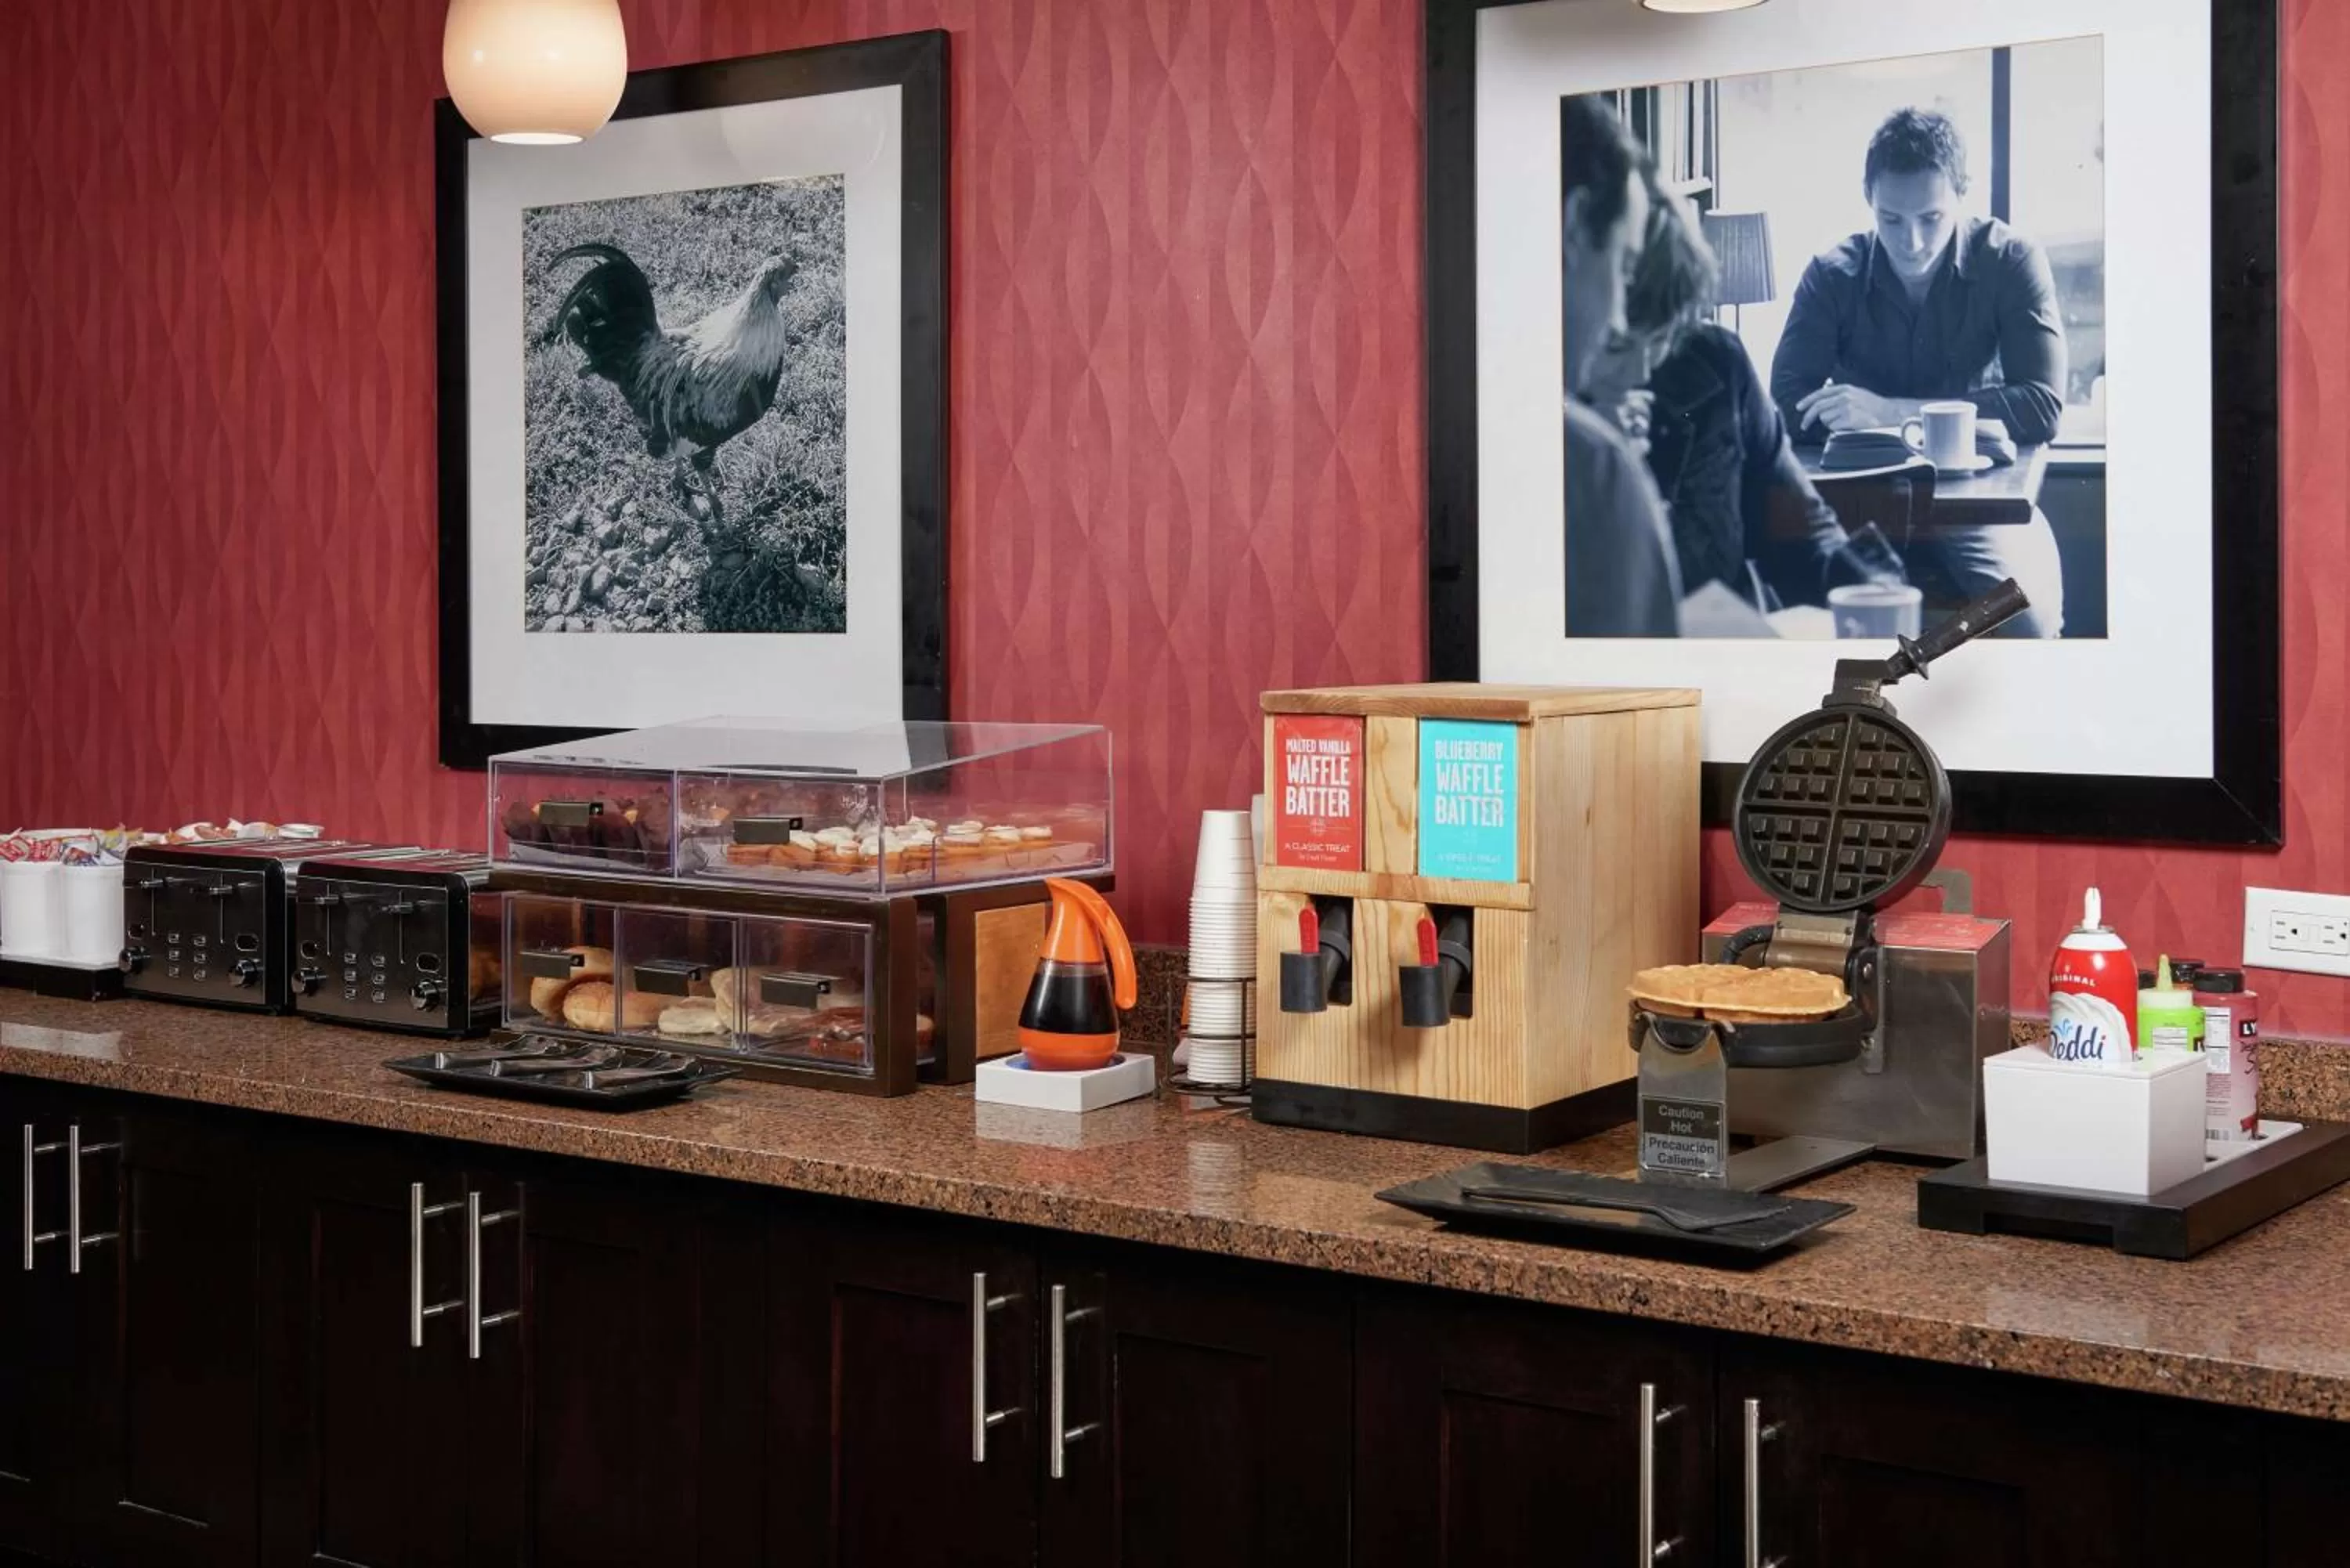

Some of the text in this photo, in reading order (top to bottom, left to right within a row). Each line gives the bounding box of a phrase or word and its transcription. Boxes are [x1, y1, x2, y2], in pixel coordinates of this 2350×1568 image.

[1285, 739, 1351, 754] MALTED VANILLA
[1434, 739, 1504, 761] BLUEBERRY
[1285, 754, 1350, 786] WAFFLE
[1434, 762, 1505, 794] WAFFLE
[1285, 786, 1350, 818] BATTER
[1434, 795, 1505, 828] BATTER
[1292, 842, 1325, 852] CLASSIC
[1325, 844, 1352, 853] TREAT
[1658, 1104, 1705, 1120] Caution
[1670, 1121, 1693, 1133] Hot
[1649, 1137, 1715, 1154] Precaución
[1658, 1153, 1705, 1168] Caliente
